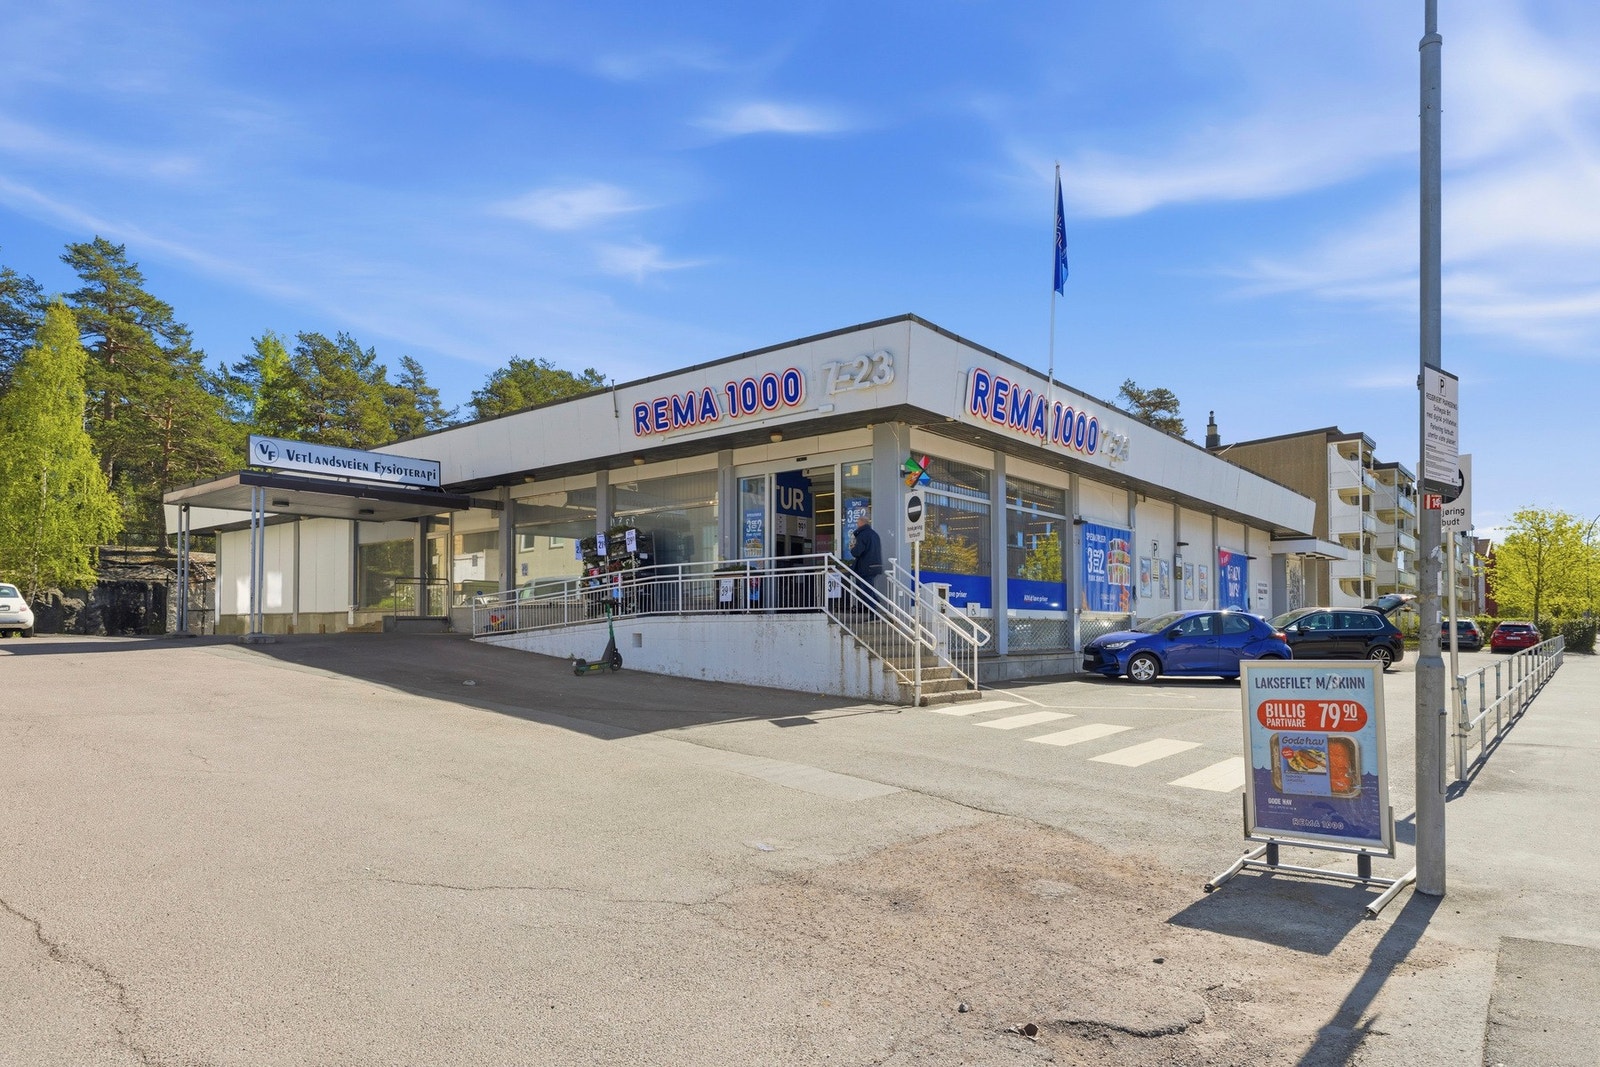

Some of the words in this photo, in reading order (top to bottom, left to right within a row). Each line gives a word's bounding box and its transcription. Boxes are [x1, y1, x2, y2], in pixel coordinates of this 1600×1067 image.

[633, 387, 719, 436] REMA
[726, 368, 803, 418] 1000
[970, 368, 1047, 439] REMA
[1052, 401, 1099, 455] 1000
[1441, 507, 1465, 517] jøring
[1441, 518, 1460, 526] budt
[1087, 547, 1093, 574] 3
[1255, 677, 1312, 689] LAKSEFILET
[1316, 675, 1366, 690] M/SKINN
[1265, 703, 1305, 718] BILLIG
[1318, 703, 1341, 728] 79
[1343, 703, 1358, 719] 90
[1266, 718, 1306, 728] PARTIVARE
